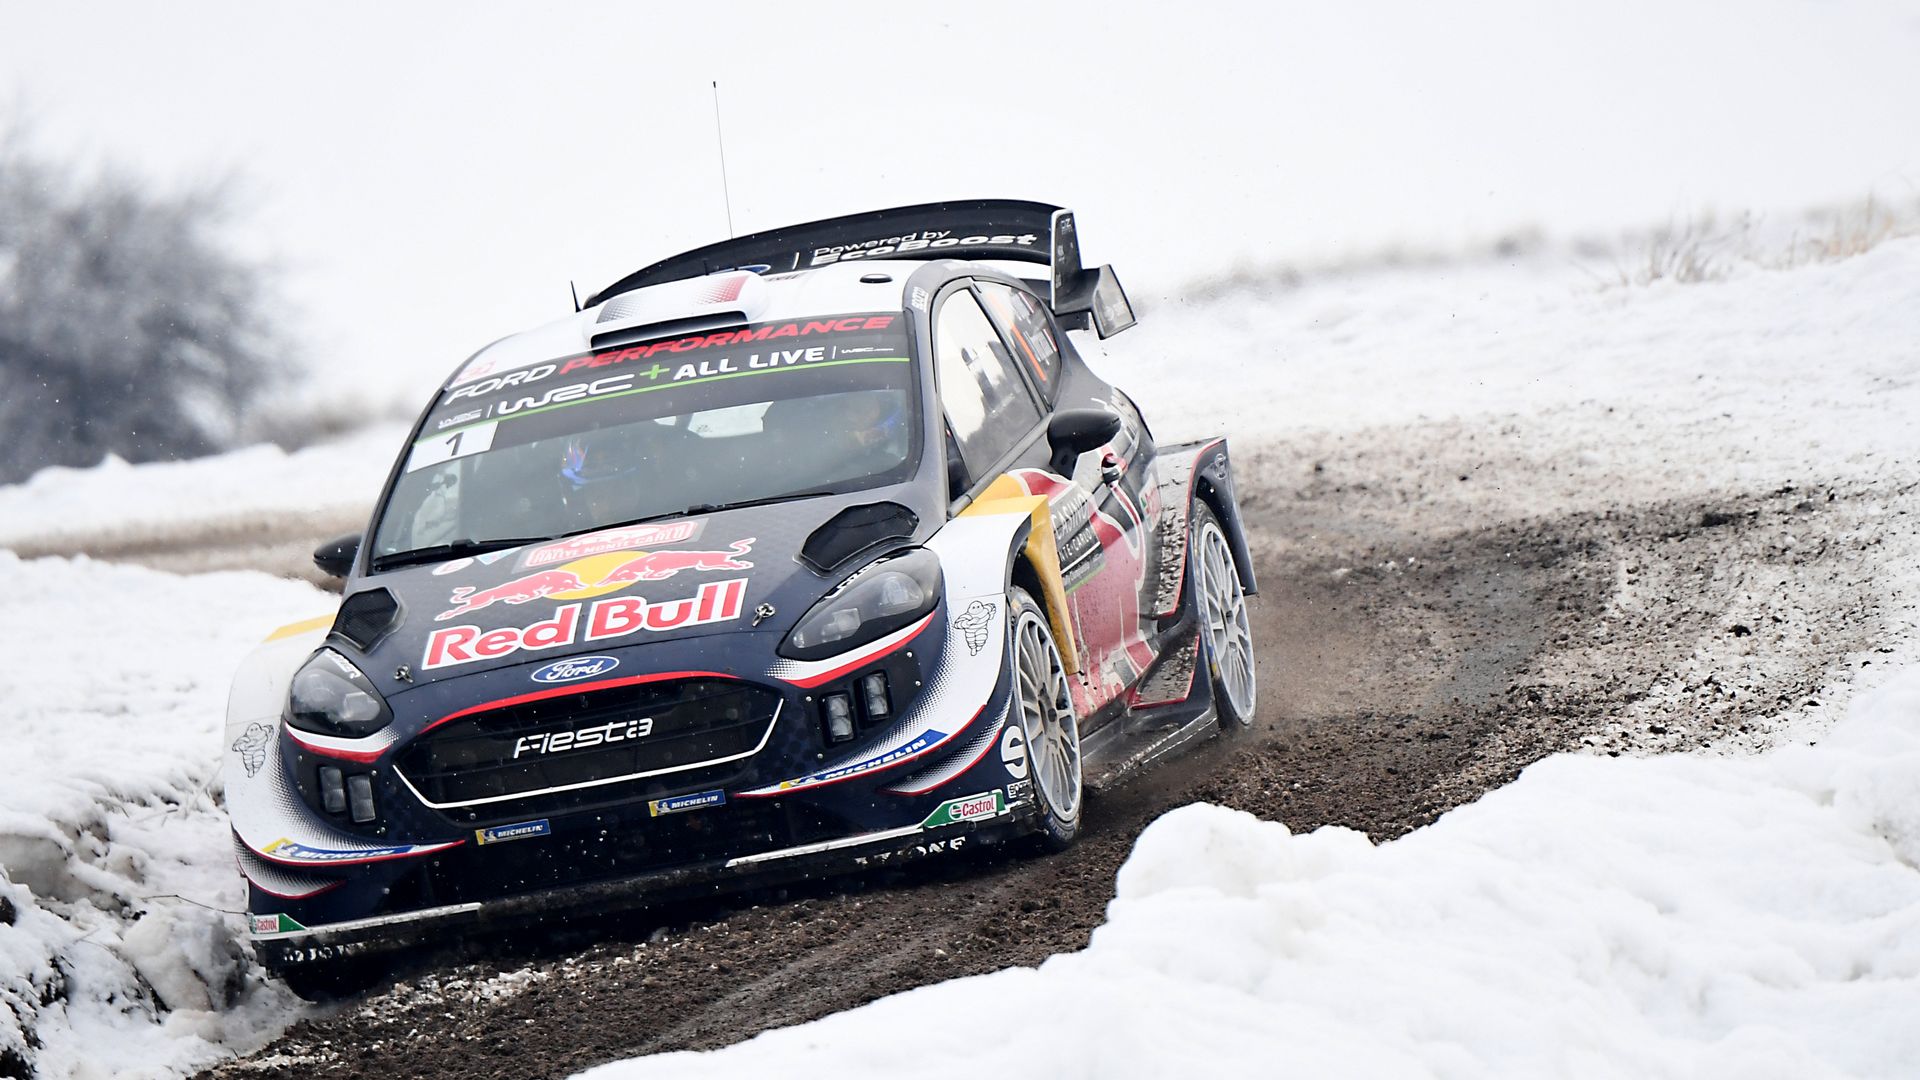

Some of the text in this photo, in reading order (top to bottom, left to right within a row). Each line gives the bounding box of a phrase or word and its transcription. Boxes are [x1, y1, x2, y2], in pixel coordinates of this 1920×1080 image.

[810, 233, 1038, 267] EcoBoost
[814, 230, 951, 257] Powered by
[444, 364, 557, 406] FORD
[559, 315, 895, 375] PERFORMANCE
[673, 360, 738, 381] ALL
[749, 346, 825, 369] LIVE
[445, 432, 465, 456] 1
[424, 603, 581, 669] Red
[586, 578, 747, 641] Bull
[546, 659, 605, 681] Ford
[513, 717, 654, 759] Fiesta
[824, 738, 928, 780] MICHELIN
[671, 794, 719, 809] MICHELIN
[961, 796, 995, 817] Castrol
[497, 824, 544, 838] MICHELIN
[294, 850, 396, 860] MICHELIN
[255, 916, 278, 932] Castrol
